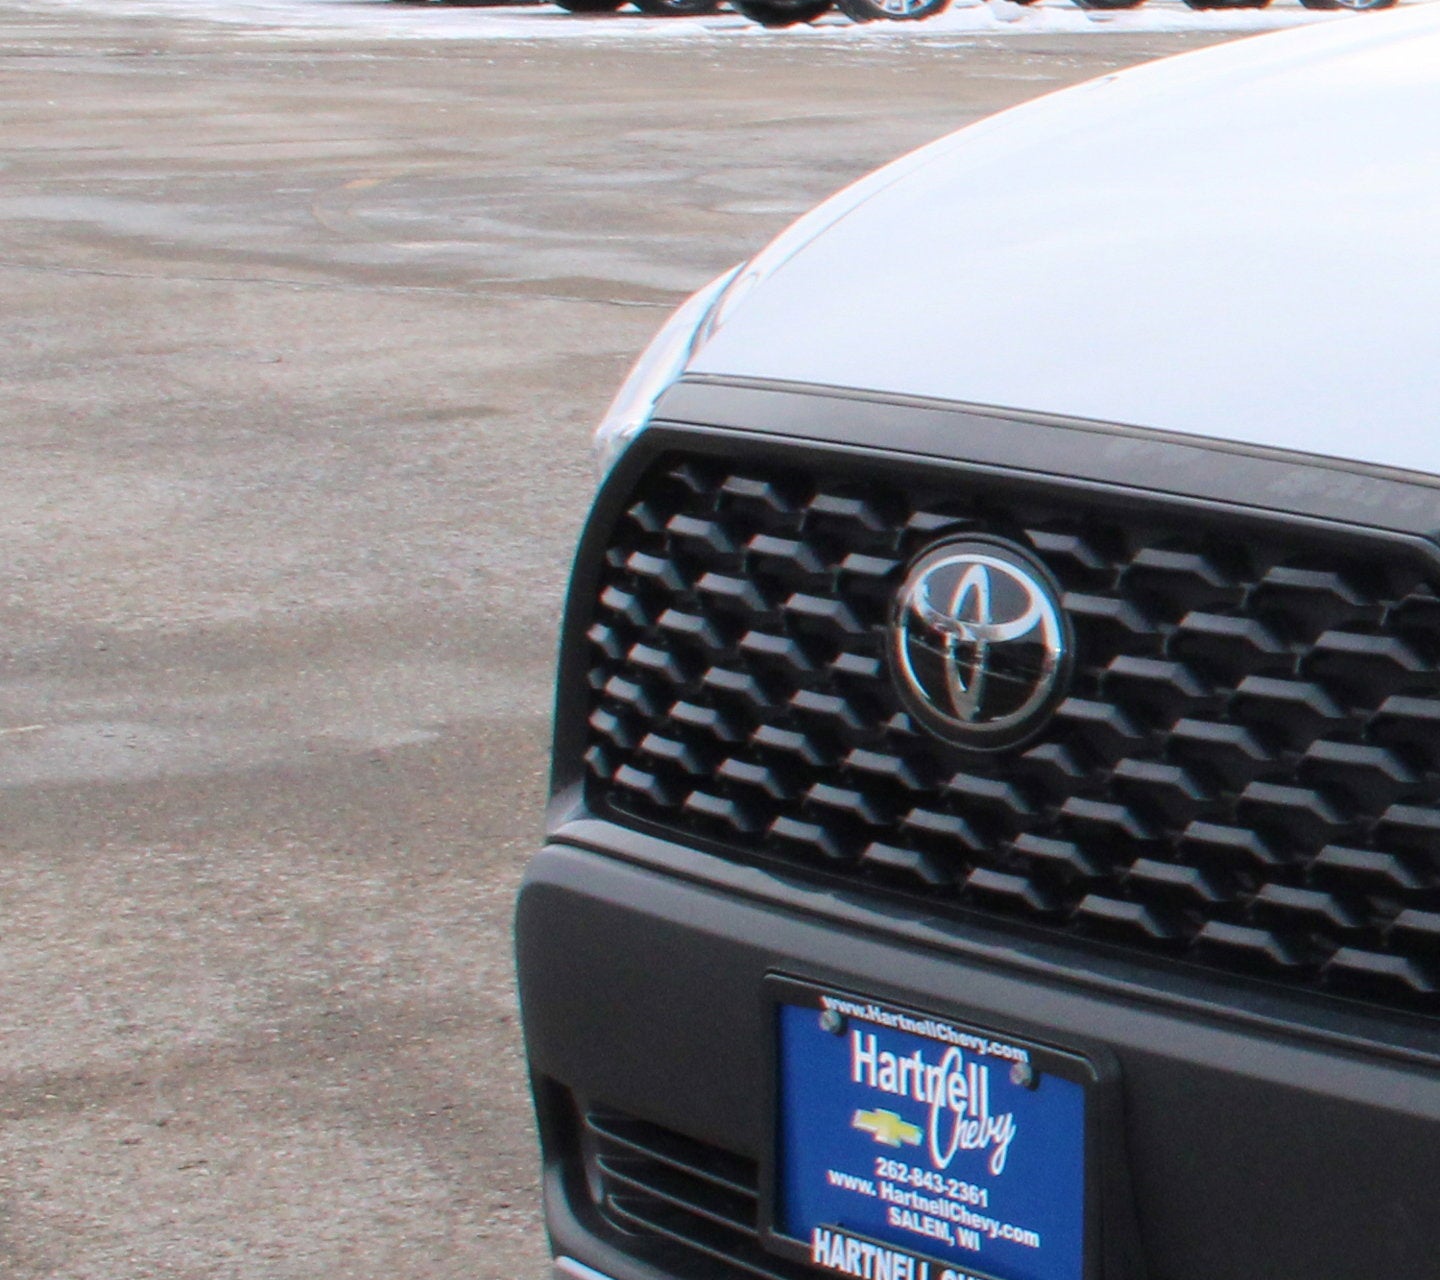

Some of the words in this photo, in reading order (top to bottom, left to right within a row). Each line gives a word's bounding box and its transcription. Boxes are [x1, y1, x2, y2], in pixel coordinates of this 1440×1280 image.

[822, 995, 1029, 1063] www.HartnellChevy.com
[852, 1029, 989, 1117] Hartnell
[930, 1045, 1017, 1176] Chevy
[875, 1156, 988, 1208] 262-843-2361
[887, 1207, 955, 1247] SALEM,
[958, 1229, 981, 1252] WI
